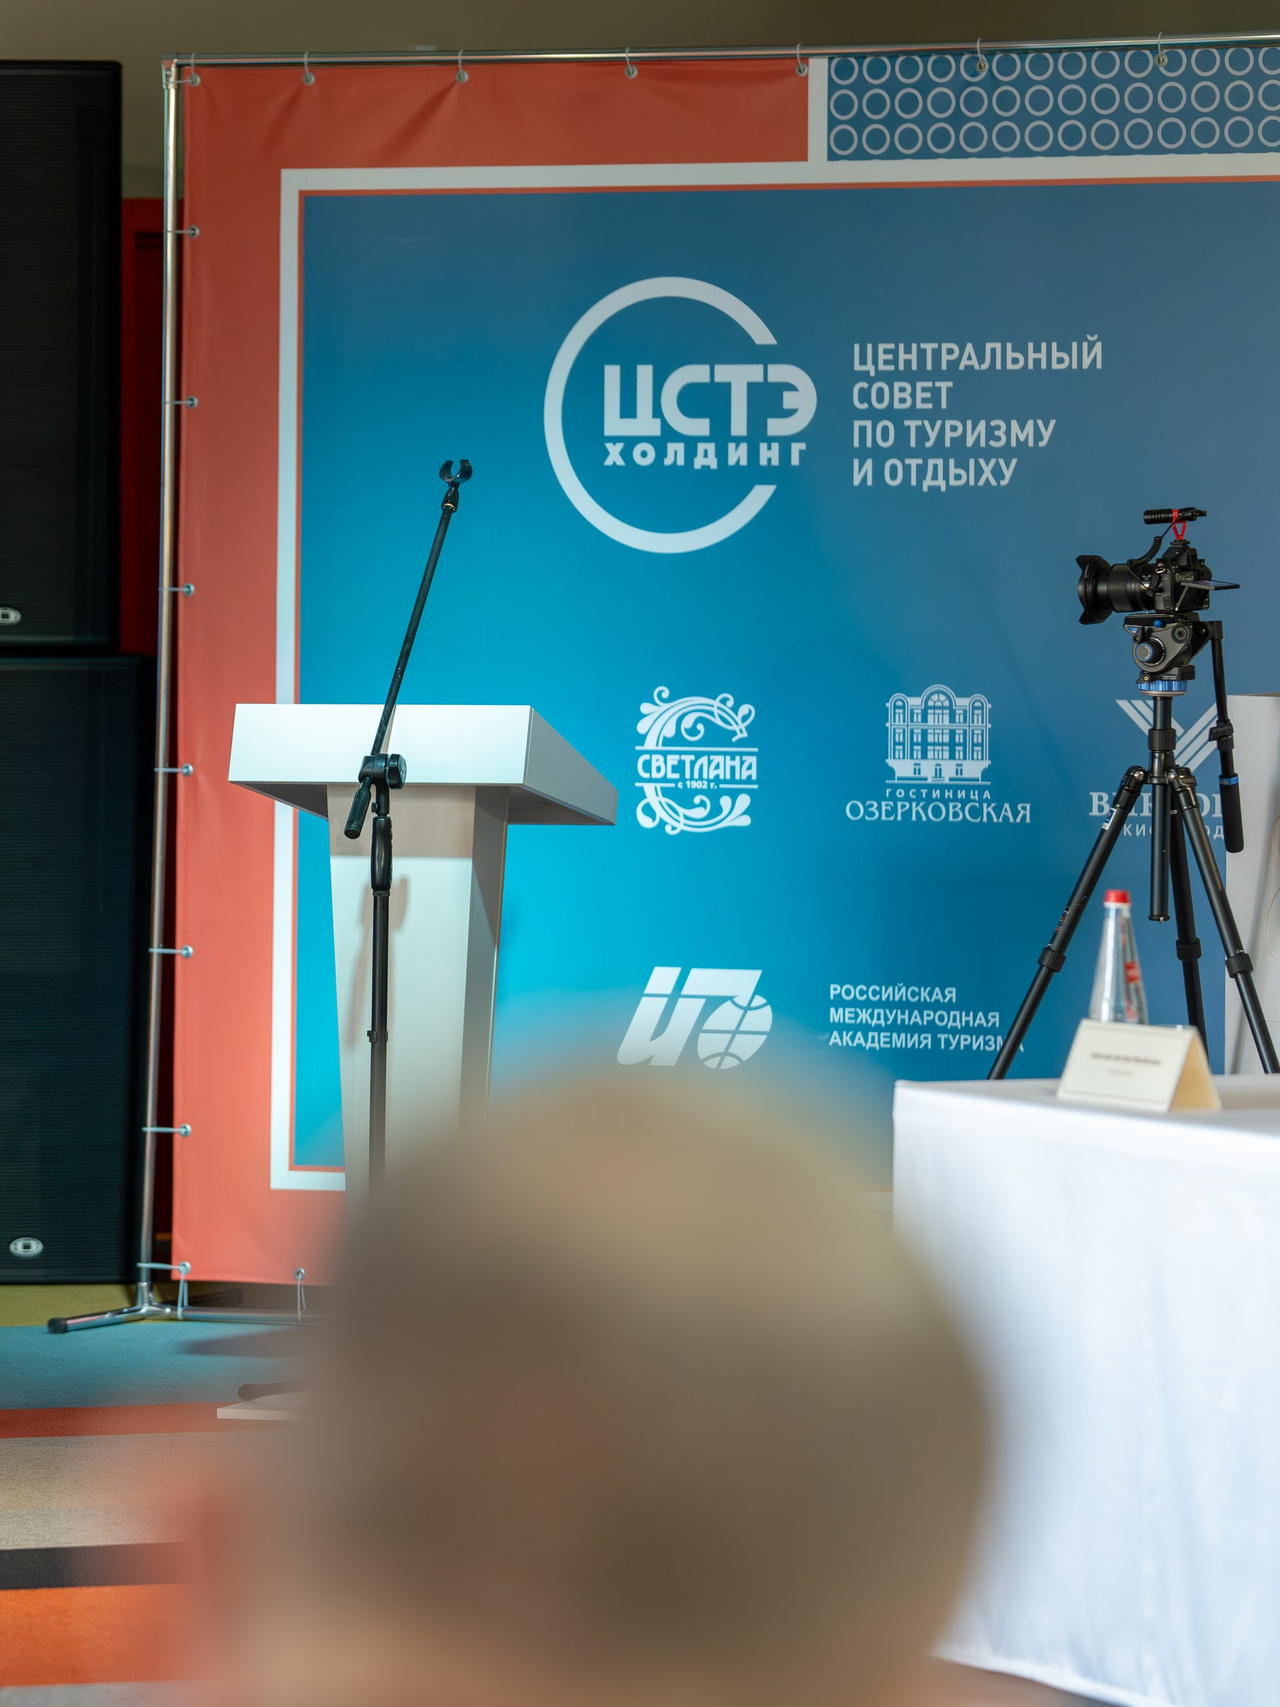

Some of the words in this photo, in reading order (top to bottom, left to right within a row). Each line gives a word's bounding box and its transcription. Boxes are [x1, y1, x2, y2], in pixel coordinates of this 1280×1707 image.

[852, 334, 1103, 376] ЦЕНТРАЛЬНЫЙ
[603, 363, 817, 437] ЦСТЭ
[852, 381, 954, 410] СОВЕТ
[852, 418, 896, 449] ПО
[904, 418, 1057, 449] ТУРИЗМУ
[603, 442, 807, 470] ХОЛДИНГ
[852, 458, 873, 487] И
[883, 458, 1018, 492] ОТДЫХУ
[636, 753, 757, 781] СВЕТЛАНА
[685, 780, 708, 789] 1902
[885, 788, 992, 801] ГОСТИНИЦА
[845, 800, 1032, 823] ОЗЕРКОВСКАЯ
[829, 982, 957, 1004] РОССИЙСКАЯ
[829, 1006, 1001, 1030] МЕЖДУНАРОДНАЯ
[829, 1030, 934, 1052] АКАДЕМИЯ
[937, 1033, 1024, 1053] ТУРИЗМ
